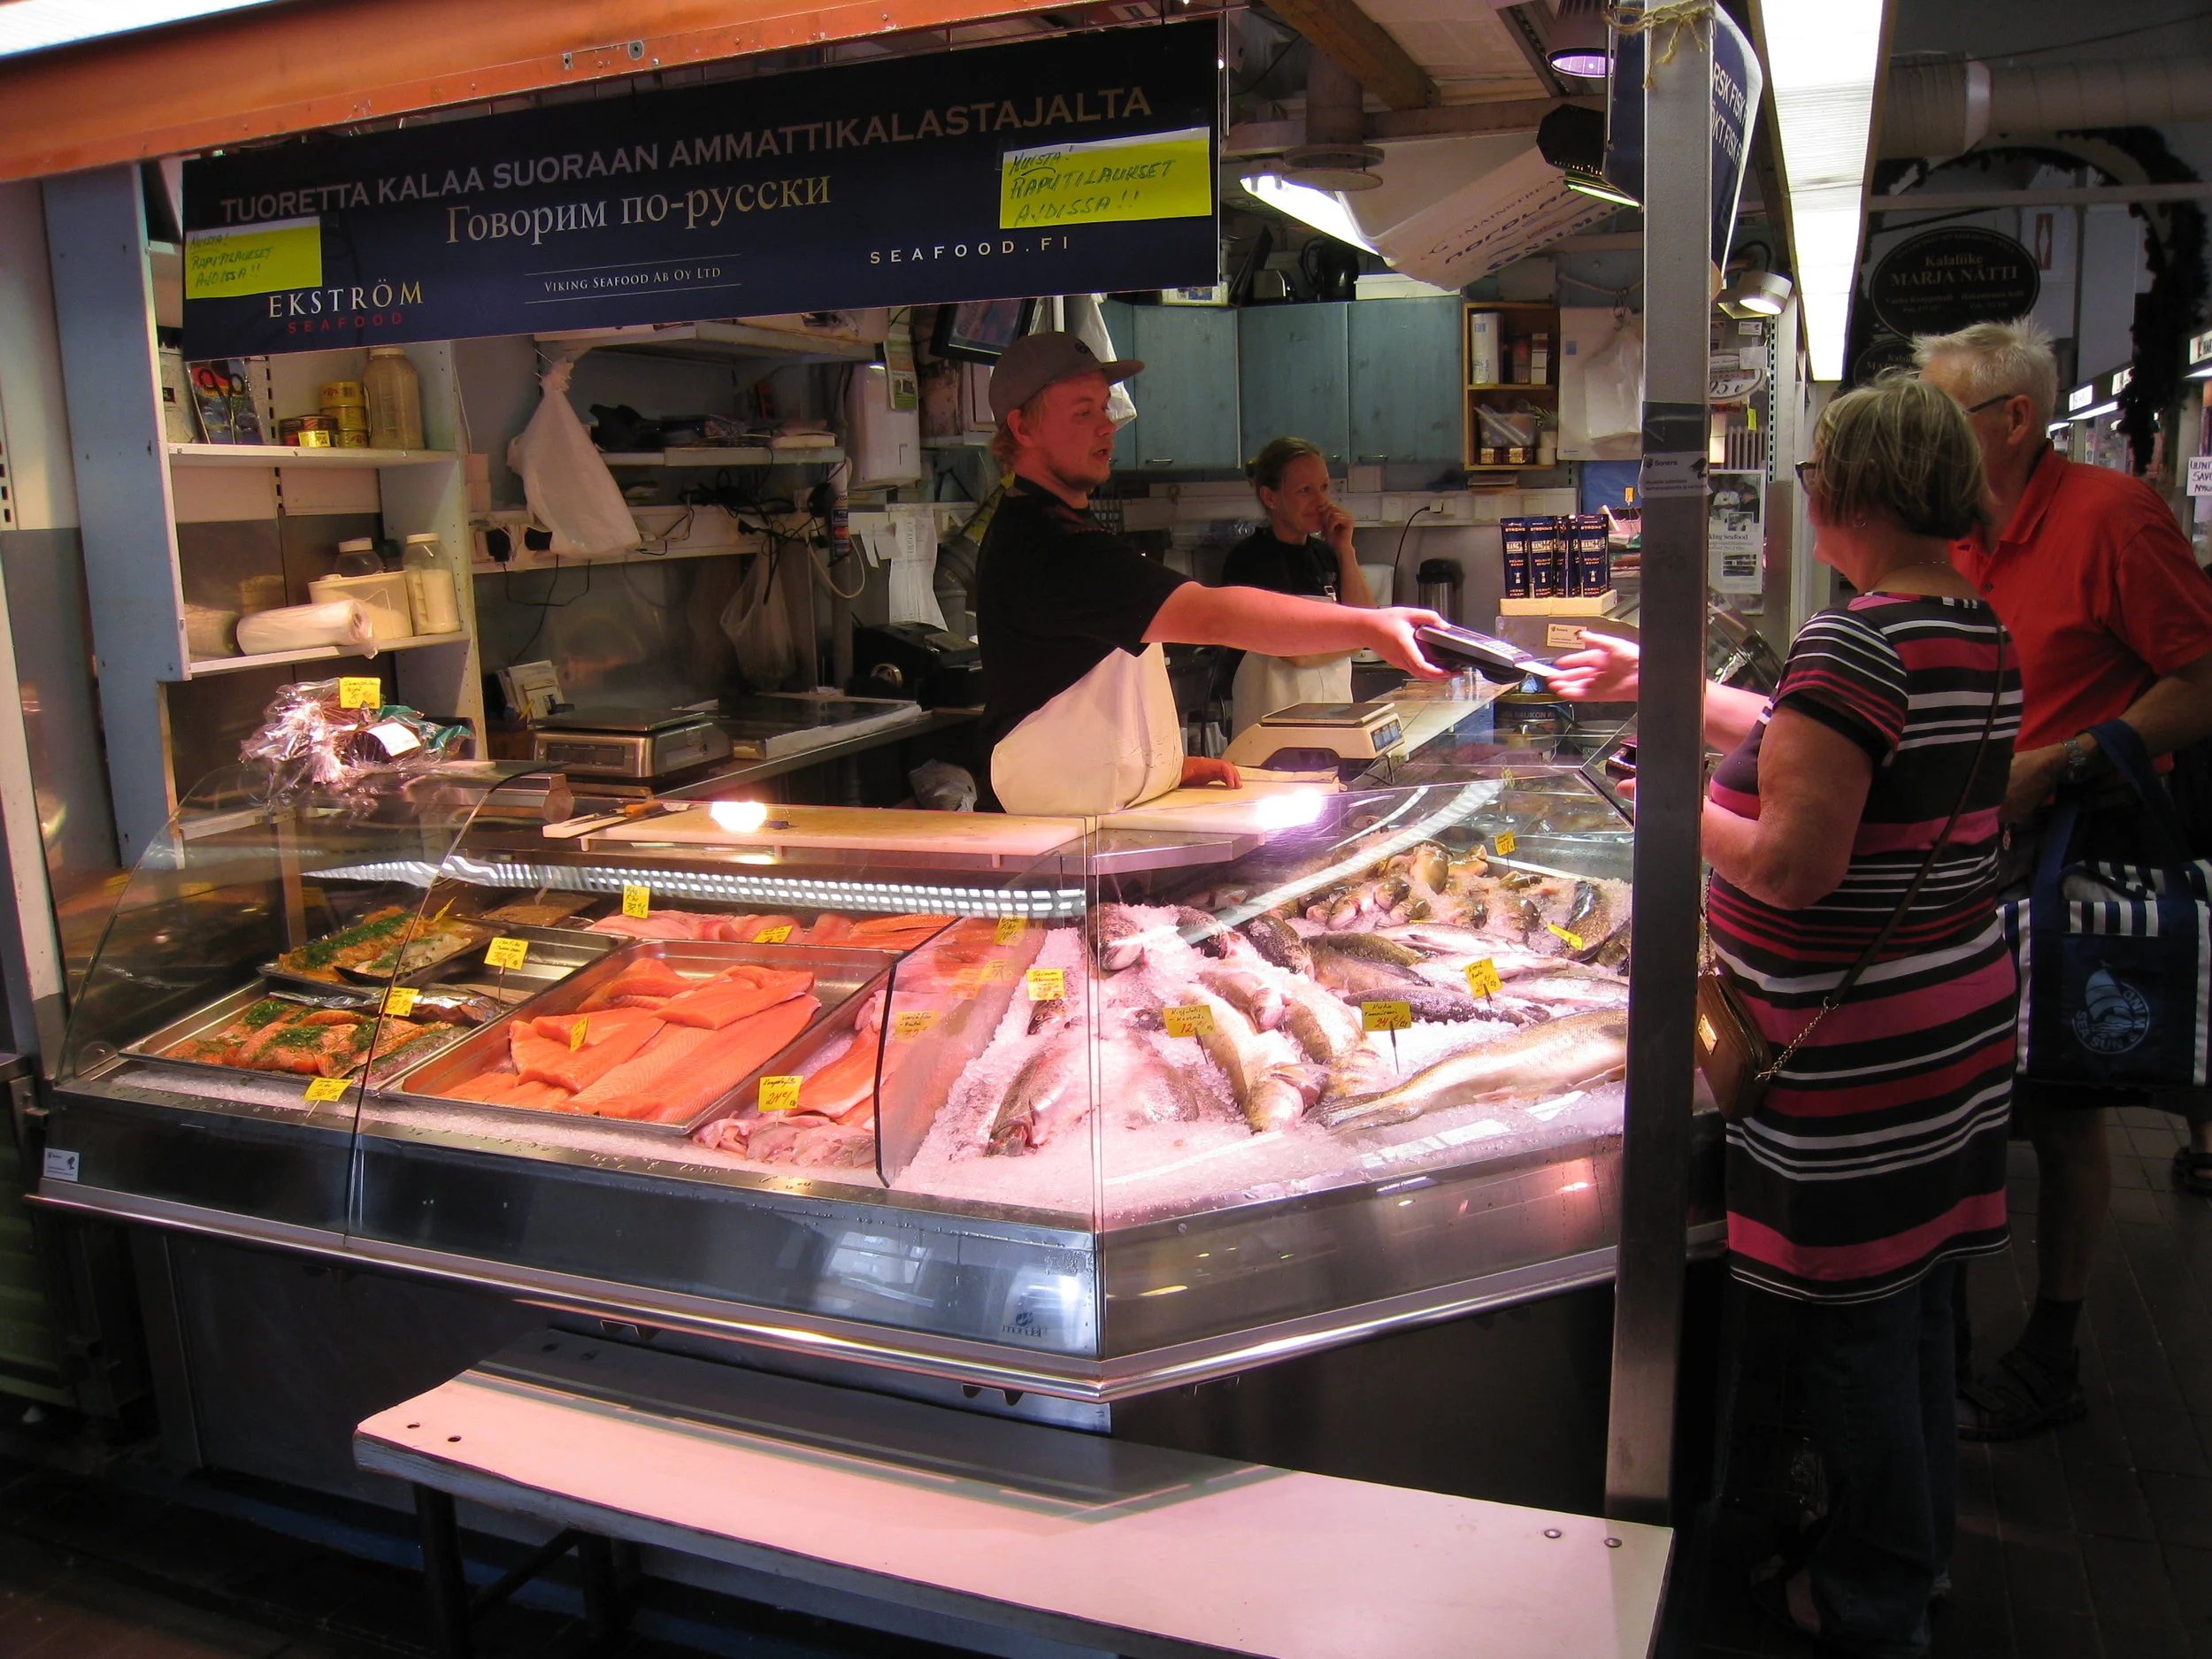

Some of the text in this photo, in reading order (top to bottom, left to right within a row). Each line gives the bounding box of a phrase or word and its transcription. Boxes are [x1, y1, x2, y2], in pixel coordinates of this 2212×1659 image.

[1712, 61, 1732, 105] RSK
[1729, 81, 1747, 125] FISK
[220, 86, 1153, 223] TUORETTA KALAA SUORAAN AMMATTIKALASTAJALTA
[1724, 123, 1740, 164] FISK
[445, 175, 832, 247] Говорим по-русски
[870, 235, 1071, 265] SEAFOOD.FI
[1924, 252, 1985, 268] Kalaliike
[1890, 264, 2019, 288] MARJA NÄTTI
[268, 279, 424, 319] EKSTRÖM
[288, 311, 403, 334] SEAFOOD
[1180, 1023, 1194, 1033] 12
[2076, 1009, 2090, 1040] SEA
[2090, 1035, 2124, 1051] SUN
